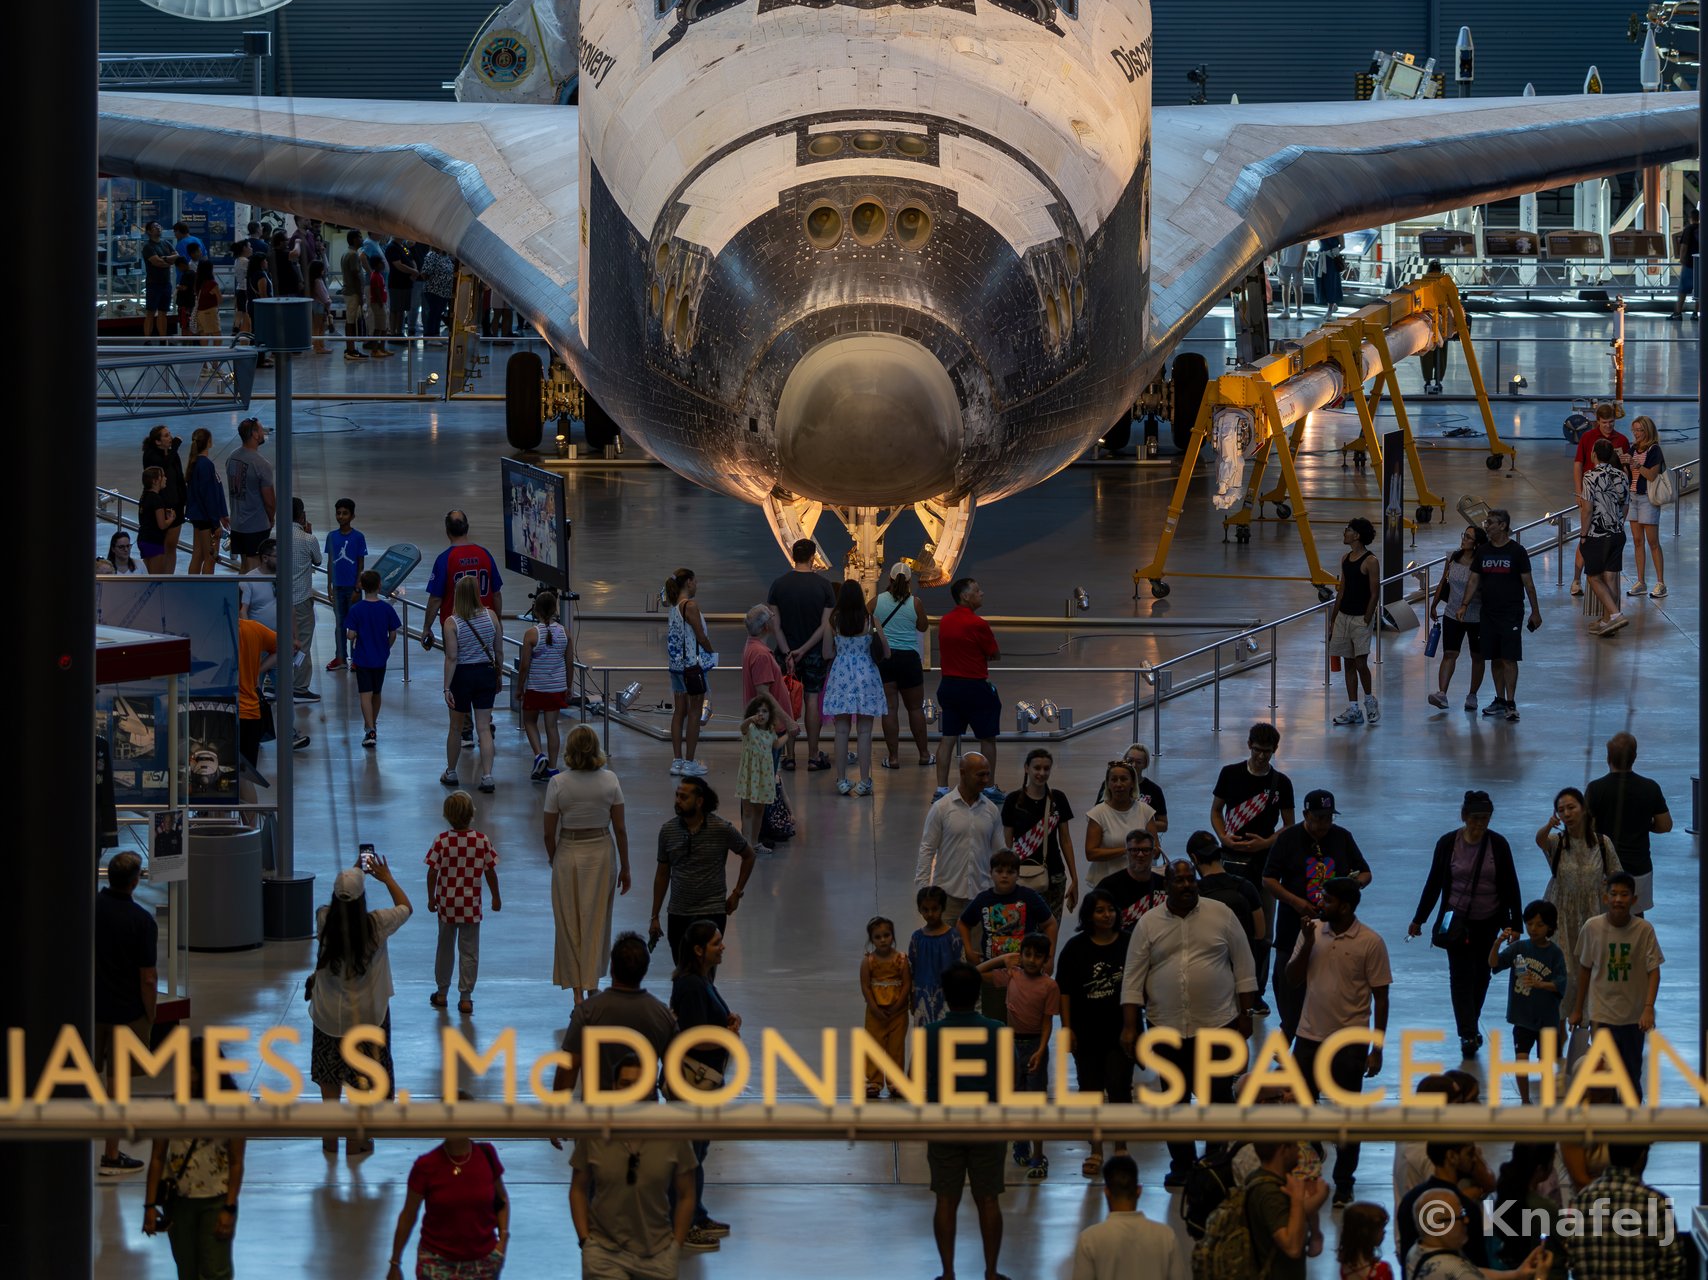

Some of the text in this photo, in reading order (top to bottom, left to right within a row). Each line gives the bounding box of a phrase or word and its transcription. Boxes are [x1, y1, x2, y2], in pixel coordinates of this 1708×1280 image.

[0, 1024, 303, 1115] JAMES
[340, 1024, 411, 1107] S.
[442, 1024, 1104, 1108] McDONNELL
[1134, 1026, 1448, 1108] SPACE
